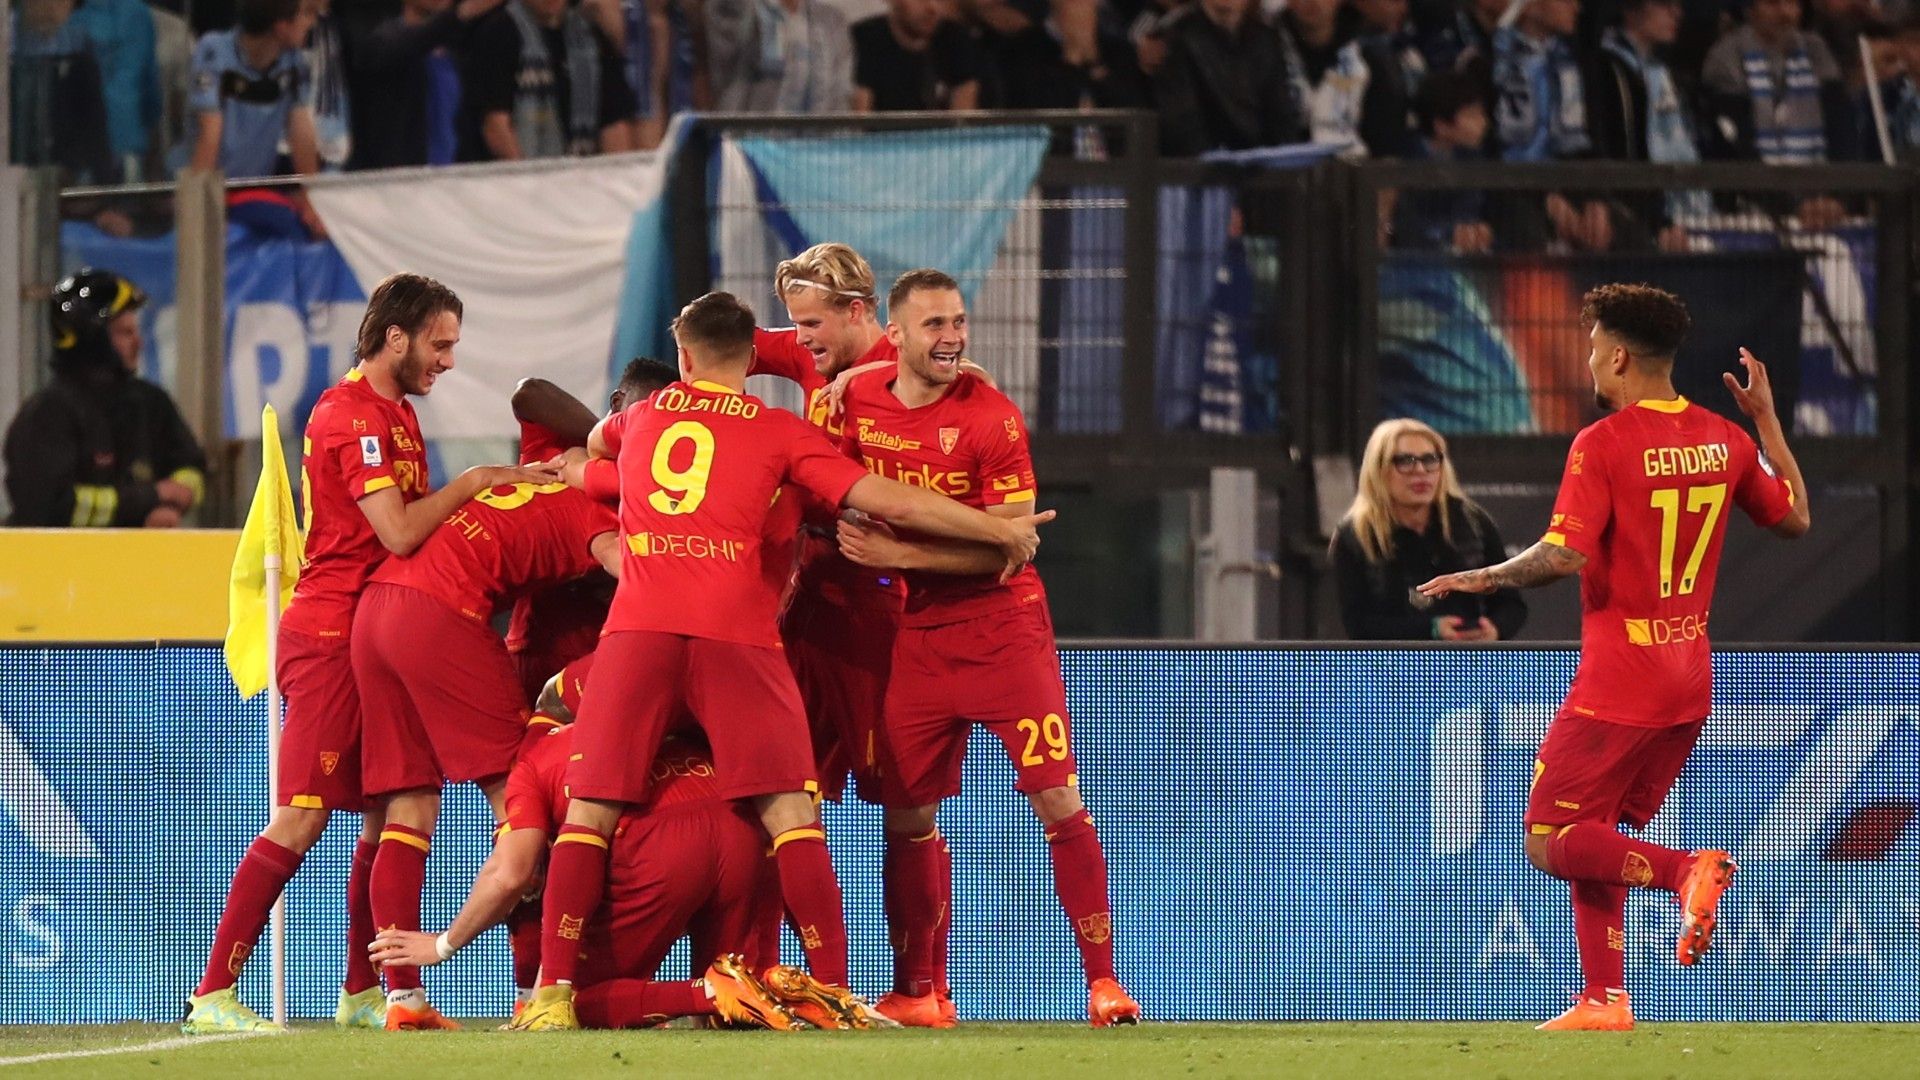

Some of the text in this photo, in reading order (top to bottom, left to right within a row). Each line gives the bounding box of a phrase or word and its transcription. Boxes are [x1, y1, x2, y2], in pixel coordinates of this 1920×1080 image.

[648, 420, 715, 516] 9
[1643, 443, 1728, 476] GENDREY
[1650, 483, 1727, 598] 17
[1653, 611, 1709, 645] DEGH
[1016, 713, 1068, 767] 29
[1474, 894, 1920, 974] ARWA
